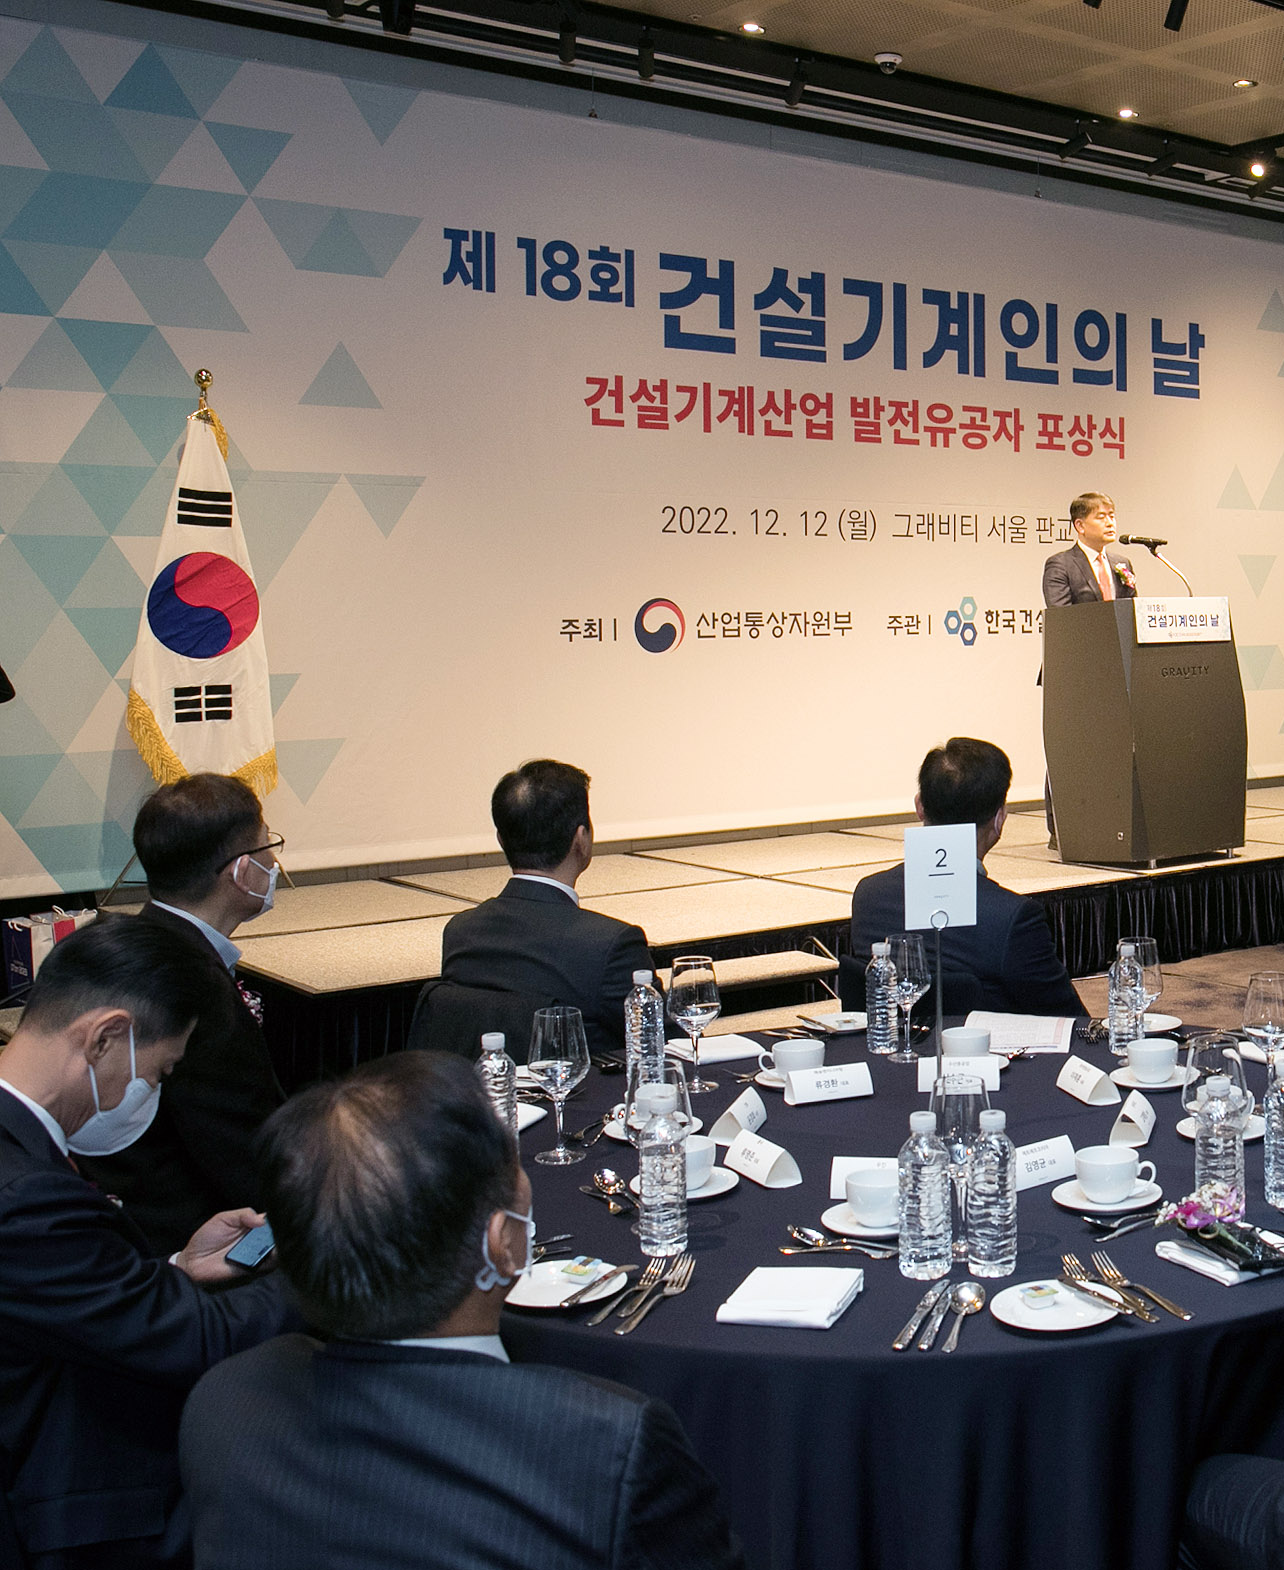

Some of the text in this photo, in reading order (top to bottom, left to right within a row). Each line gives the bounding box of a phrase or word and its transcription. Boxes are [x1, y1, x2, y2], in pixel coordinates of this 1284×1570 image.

[443, 227, 1205, 400] 제 18회 건설기계인의 날
[584, 375, 1125, 460] 건설기계산업 발전유공자 포상식
[661, 505, 1075, 544] 2022. 12. 12 (월) 그래비티 서울 판교
[559, 617, 603, 643] 주최
[696, 611, 853, 640] 산업통상자원부
[887, 614, 921, 636] 주관
[1147, 613, 1219, 628] 건설기계인의 날
[1161, 665, 1210, 680] GRAVITY
[935, 848, 947, 868] 2
